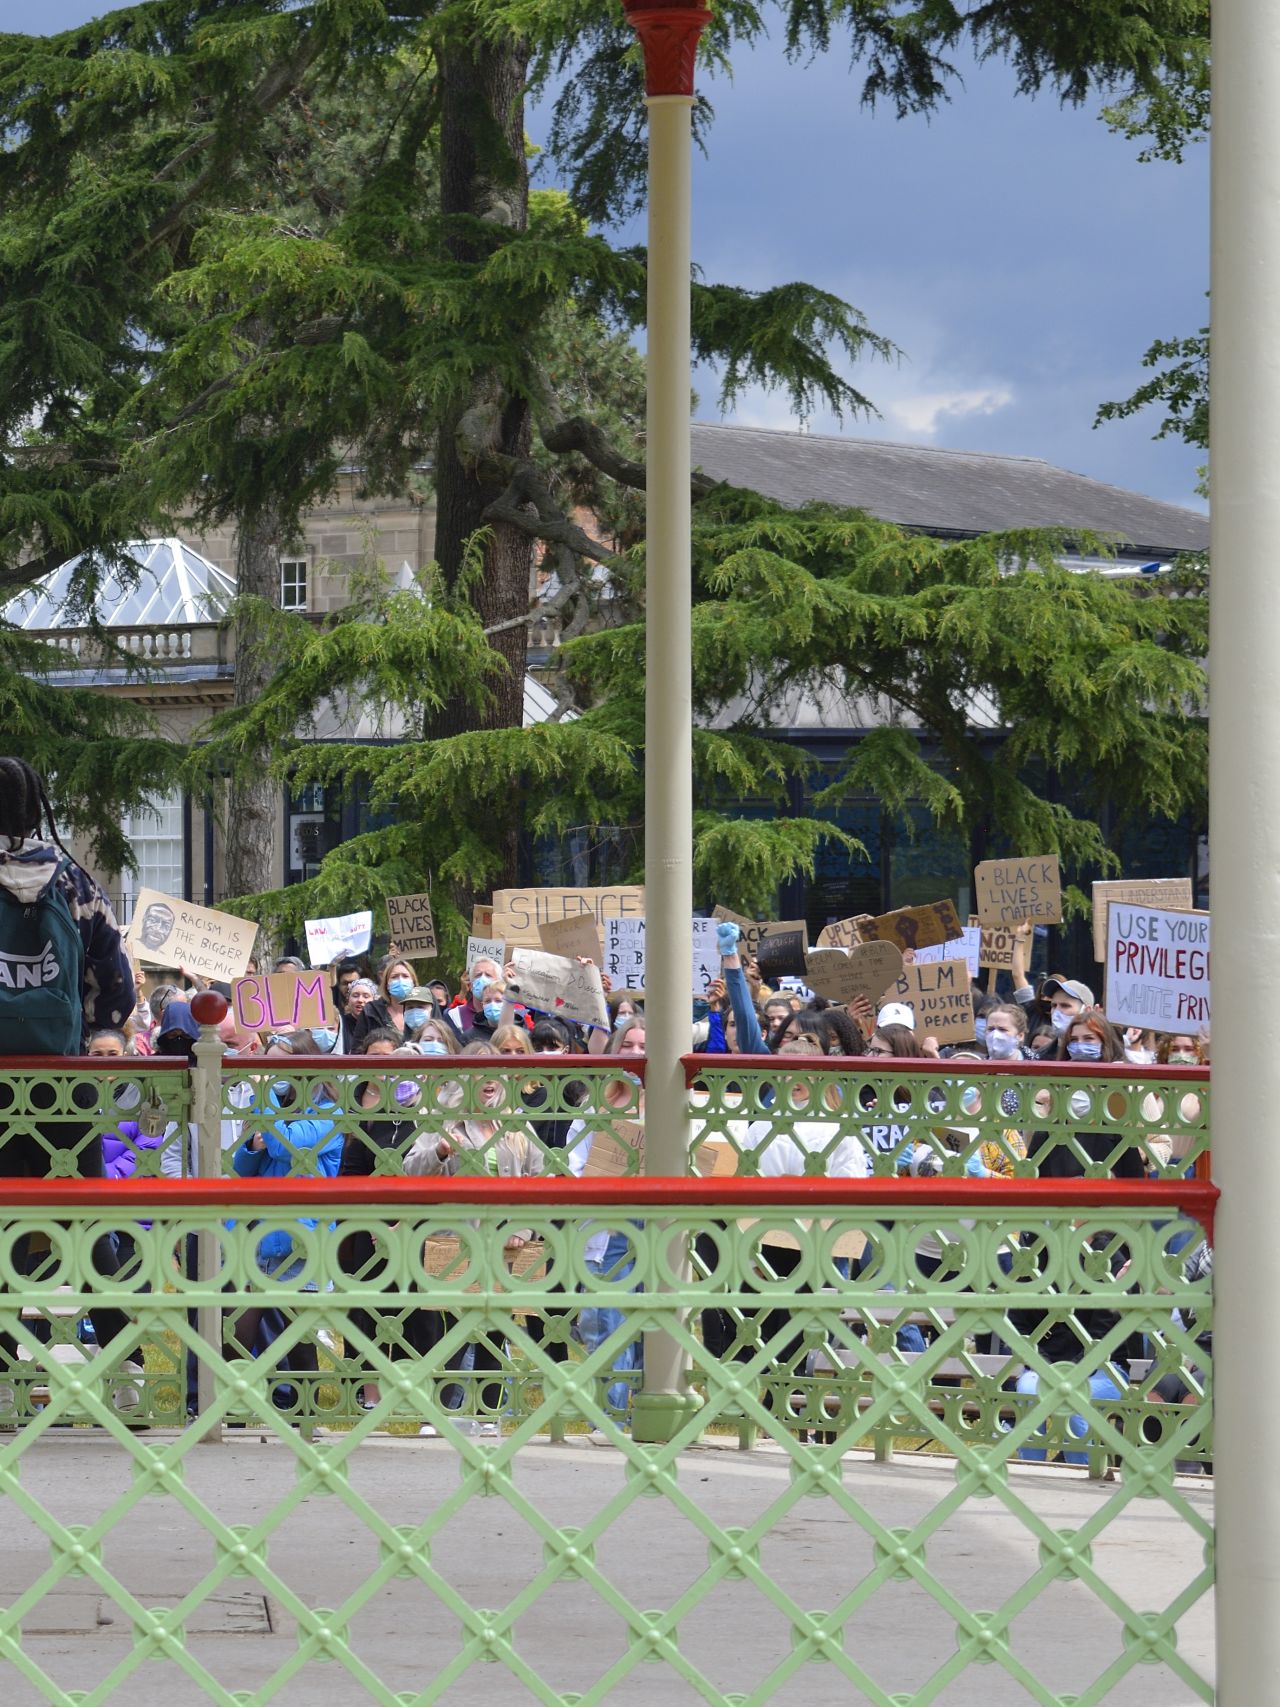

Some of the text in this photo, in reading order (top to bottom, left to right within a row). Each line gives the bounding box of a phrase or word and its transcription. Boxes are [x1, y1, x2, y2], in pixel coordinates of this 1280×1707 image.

[993, 863, 1054, 886] BLACK
[989, 886, 1039, 905] LIVES
[388, 898, 429, 916] BLACK
[510, 894, 639, 930] SILENCE
[1000, 902, 1055, 922] MATTER
[180, 912, 240, 942] RACISM IS
[391, 915, 432, 935] LIVES
[610, 920, 635, 936] HOW
[1117, 911, 1209, 944] USE YOUR
[175, 928, 242, 960] THE BIGGER
[393, 936, 435, 952] MATTER
[470, 943, 503, 956] BLACK
[609, 938, 646, 951] PEOPL
[174, 946, 235, 976] PANDEMIC
[1116, 939, 1210, 982] PRIVILEG
[237, 975, 328, 1028] BLM
[920, 994, 969, 1012] JUSTICE
[1115, 981, 1173, 1019] WHITE
[924, 1013, 969, 1028] PEACE
